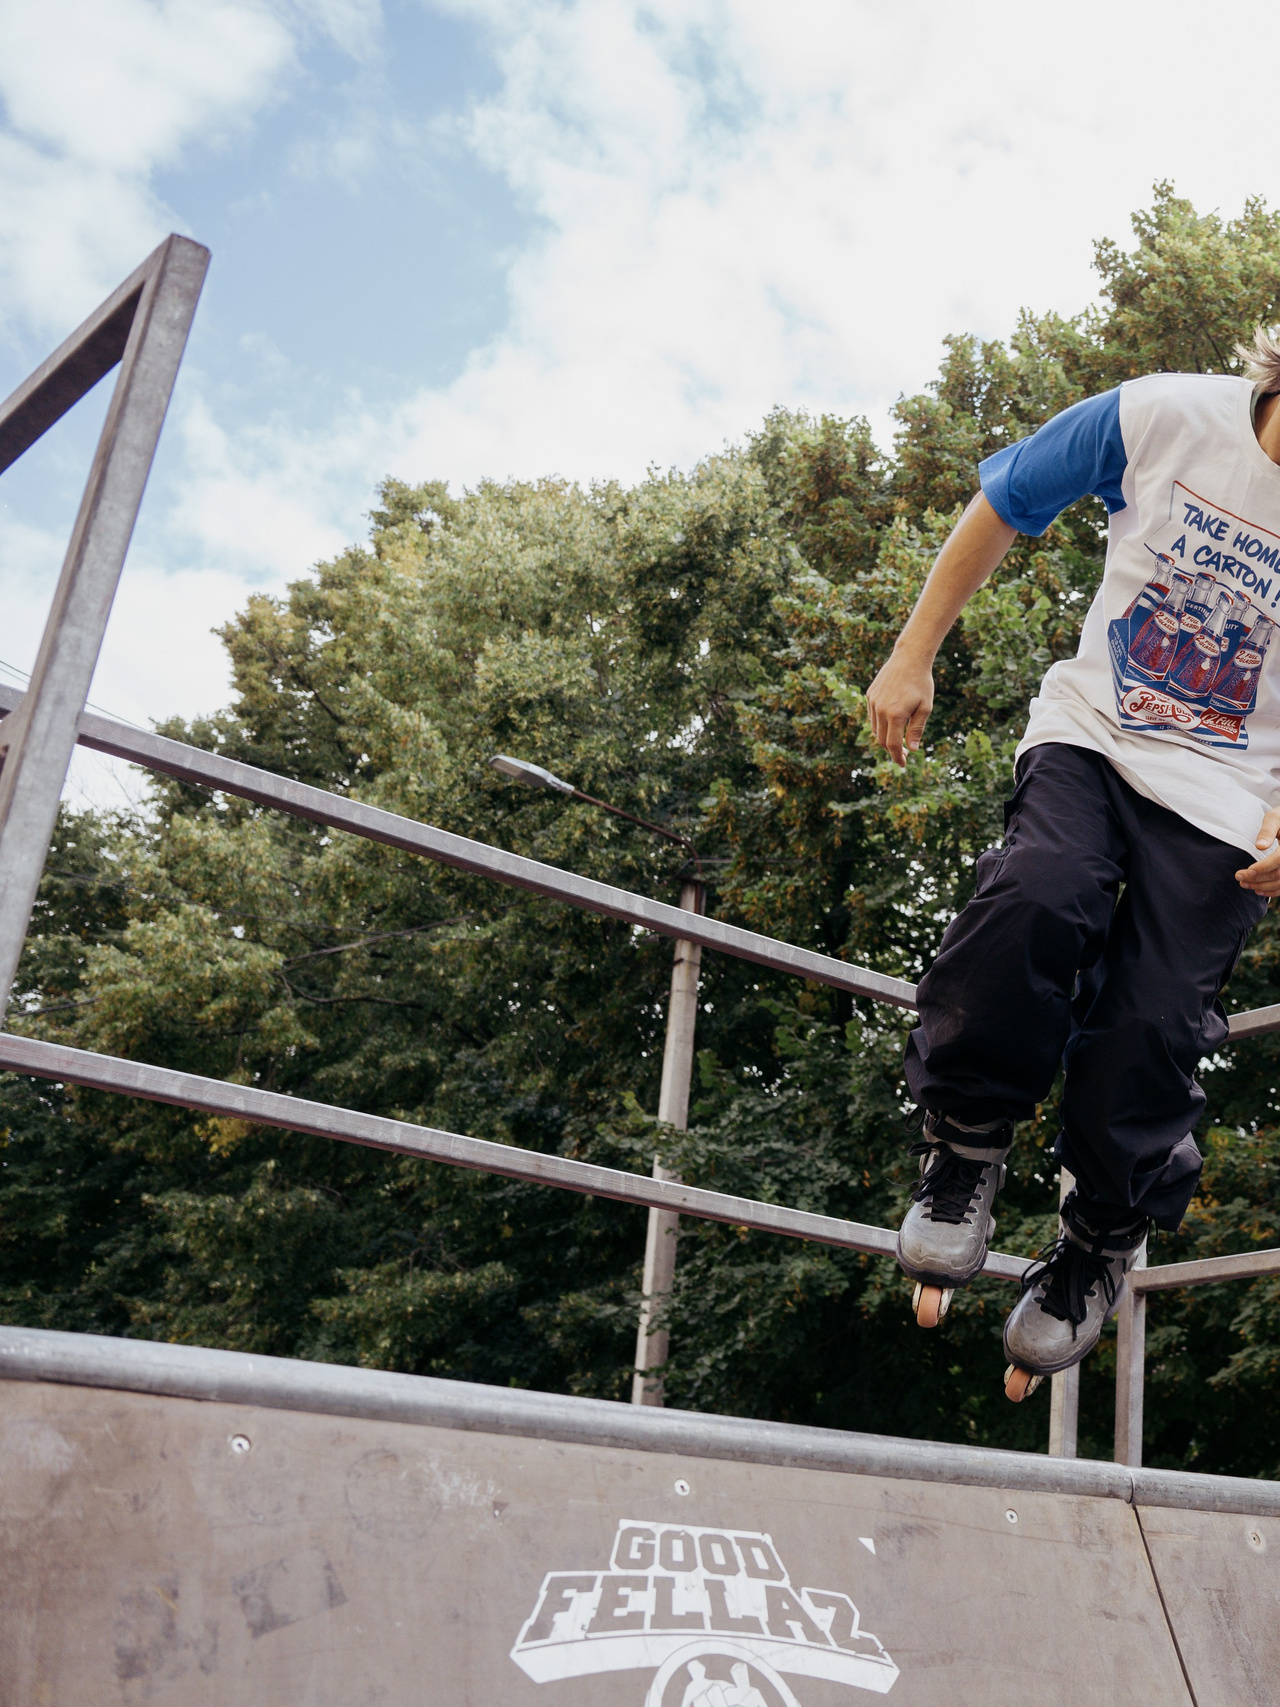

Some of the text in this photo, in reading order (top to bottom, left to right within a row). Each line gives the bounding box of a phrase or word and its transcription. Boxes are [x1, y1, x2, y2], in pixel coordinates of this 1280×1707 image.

[1184, 502, 1230, 541] TAKE
[1171, 534, 1186, 558] A
[1156, 612, 1164, 620] 2
[1195, 635, 1205, 643] 2
[1236, 650, 1245, 659] 2
[1216, 716, 1237, 728] FULL
[612, 1524, 788, 1582] GOOD
[520, 1573, 890, 1660] FELLAZ
